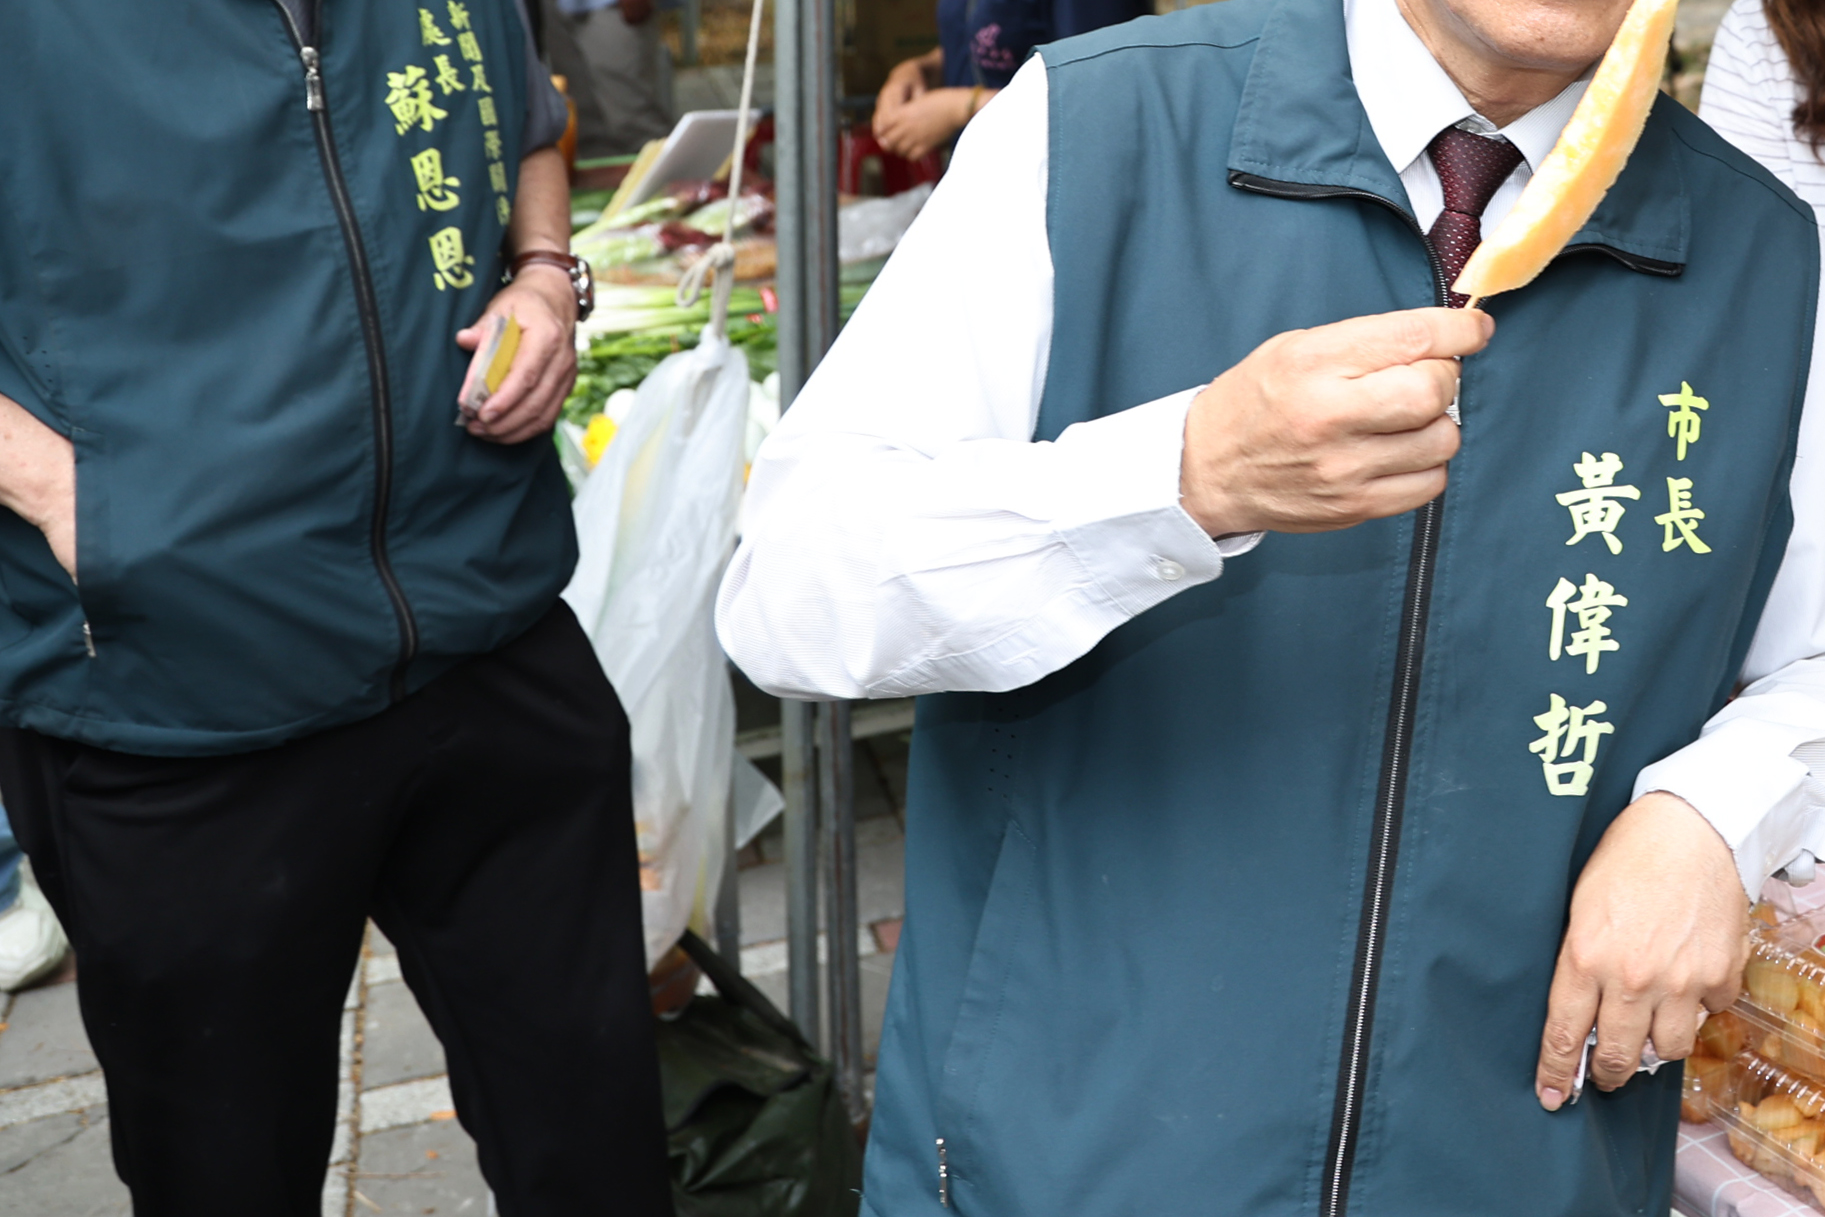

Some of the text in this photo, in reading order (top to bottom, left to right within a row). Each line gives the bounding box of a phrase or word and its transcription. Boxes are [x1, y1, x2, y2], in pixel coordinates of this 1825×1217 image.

[418, 7, 467, 97] 處長
[385, 64, 476, 291] 蘇恩恩
[1653, 380, 1712, 555] 市長
[1528, 450, 1642, 798] 黃偉哲
